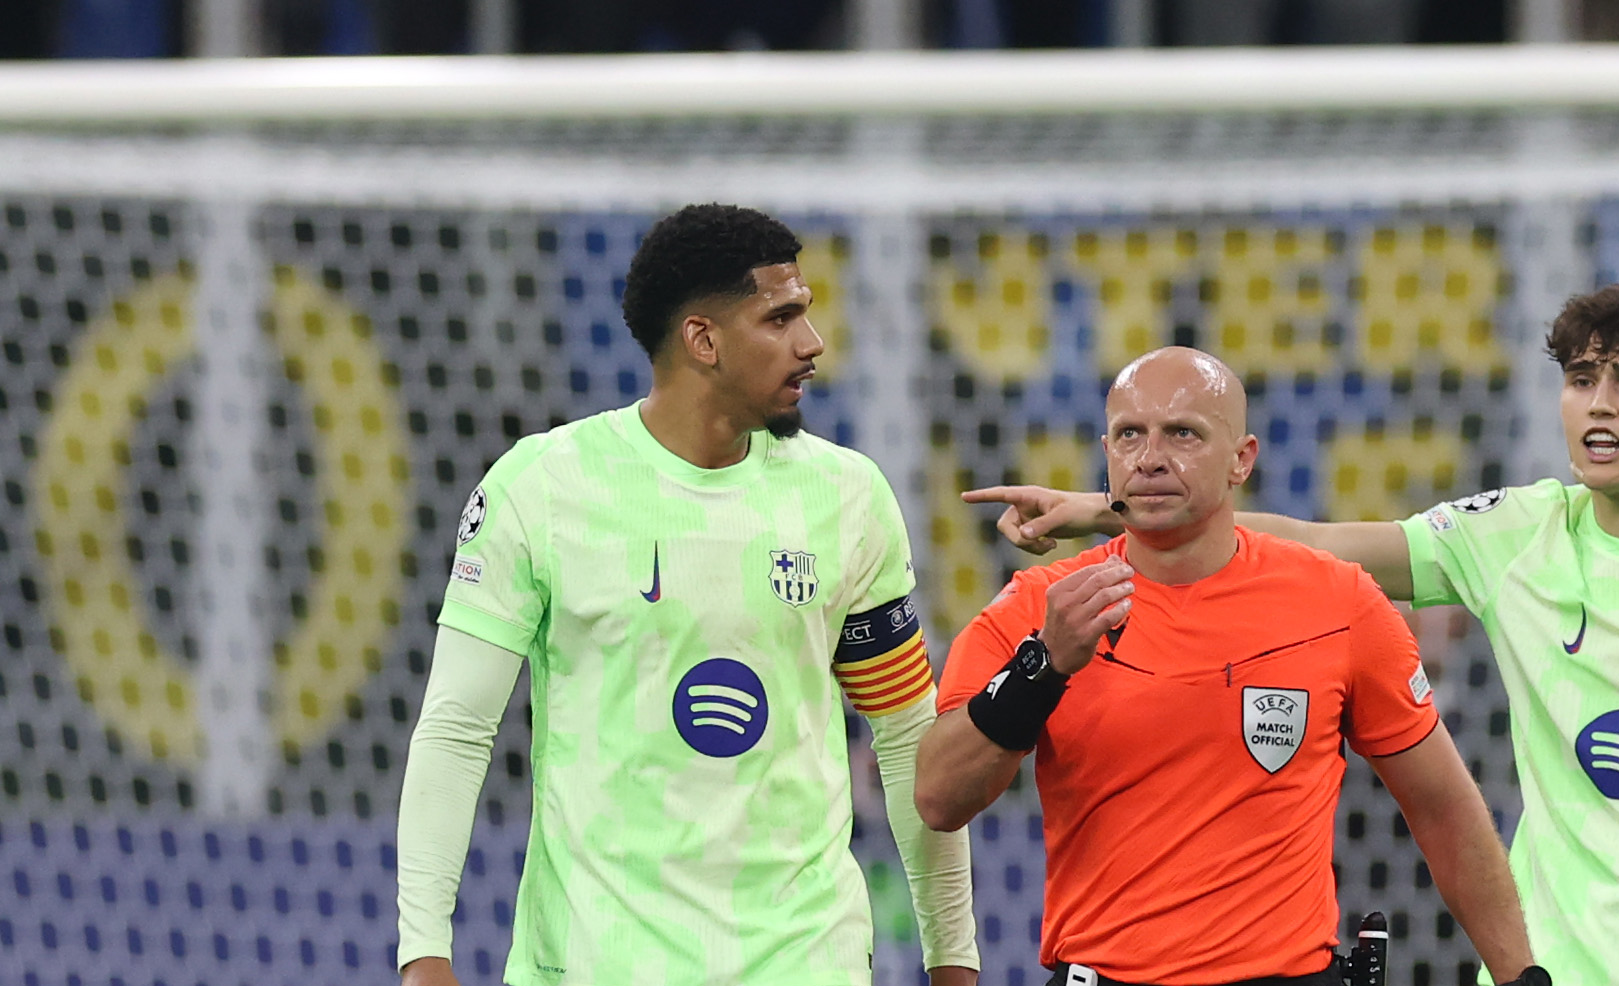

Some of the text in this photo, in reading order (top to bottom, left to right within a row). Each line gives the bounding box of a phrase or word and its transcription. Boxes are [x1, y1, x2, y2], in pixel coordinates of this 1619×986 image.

[842, 623, 872, 641] ECT
[1255, 697, 1295, 714] UEFA
[1256, 722, 1294, 734] MATCH
[1251, 734, 1295, 747] OFFICIAL
